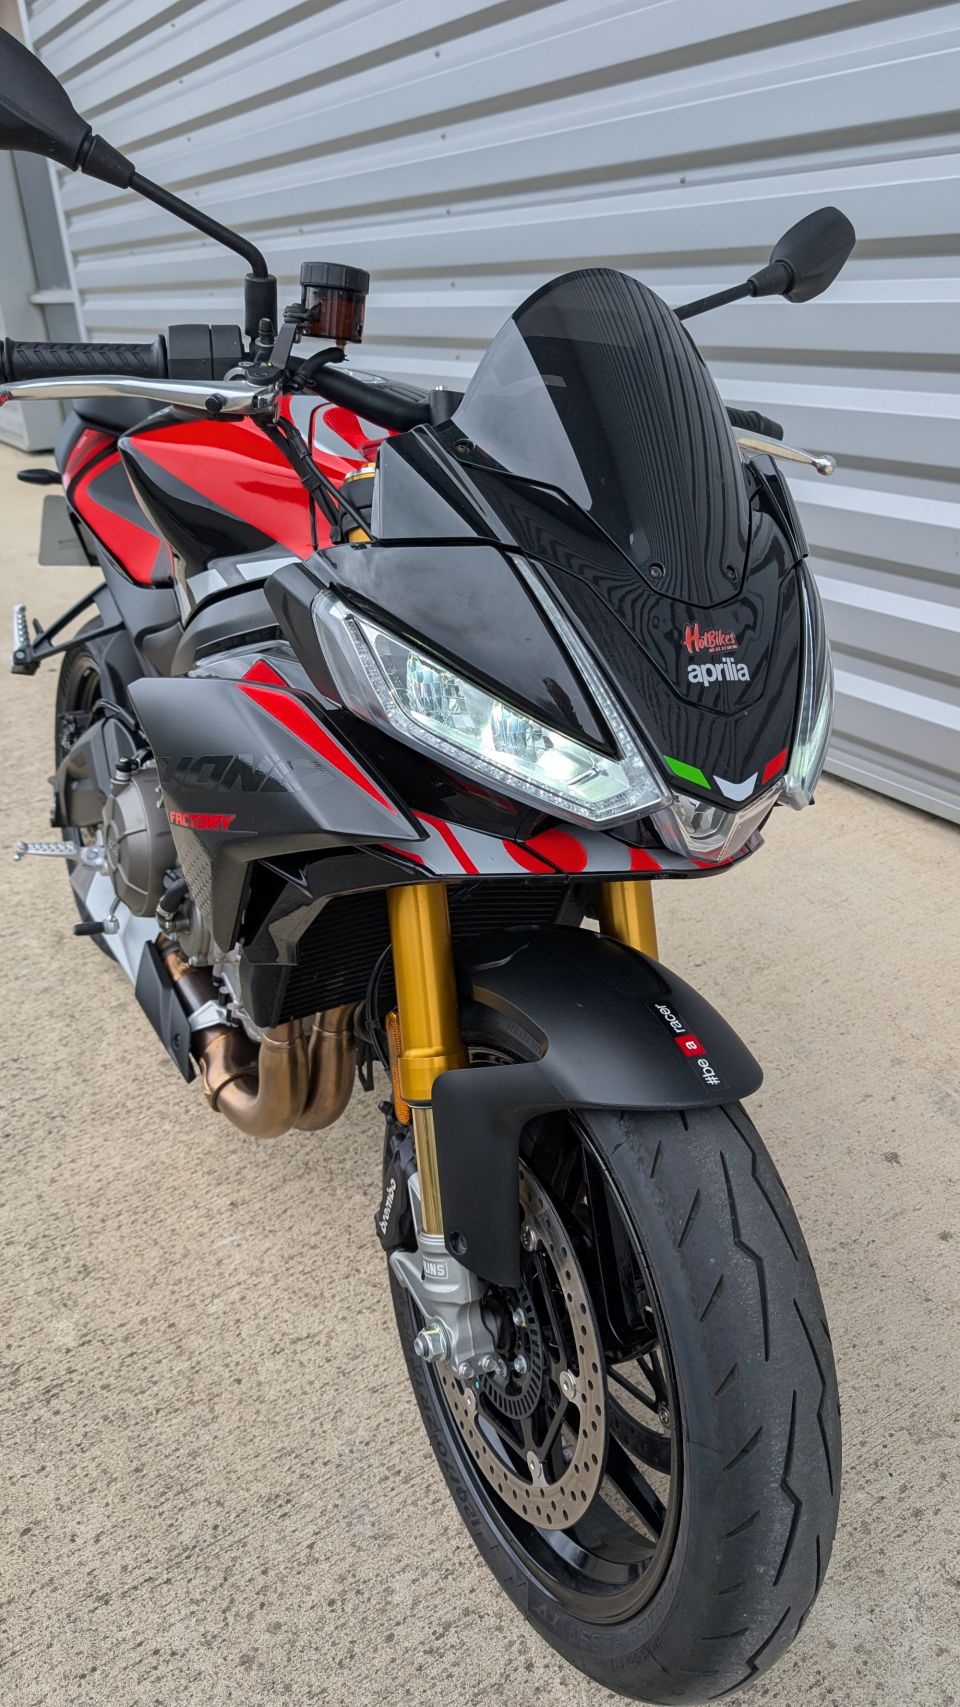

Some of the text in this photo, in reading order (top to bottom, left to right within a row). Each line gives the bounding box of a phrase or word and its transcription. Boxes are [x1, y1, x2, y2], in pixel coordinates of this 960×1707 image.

[687, 657, 750, 686] aprilia
[169, 810, 236, 831] FACTORY
[654, 1003, 720, 1085] #be a racer
[379, 1178, 396, 1235] brembo
